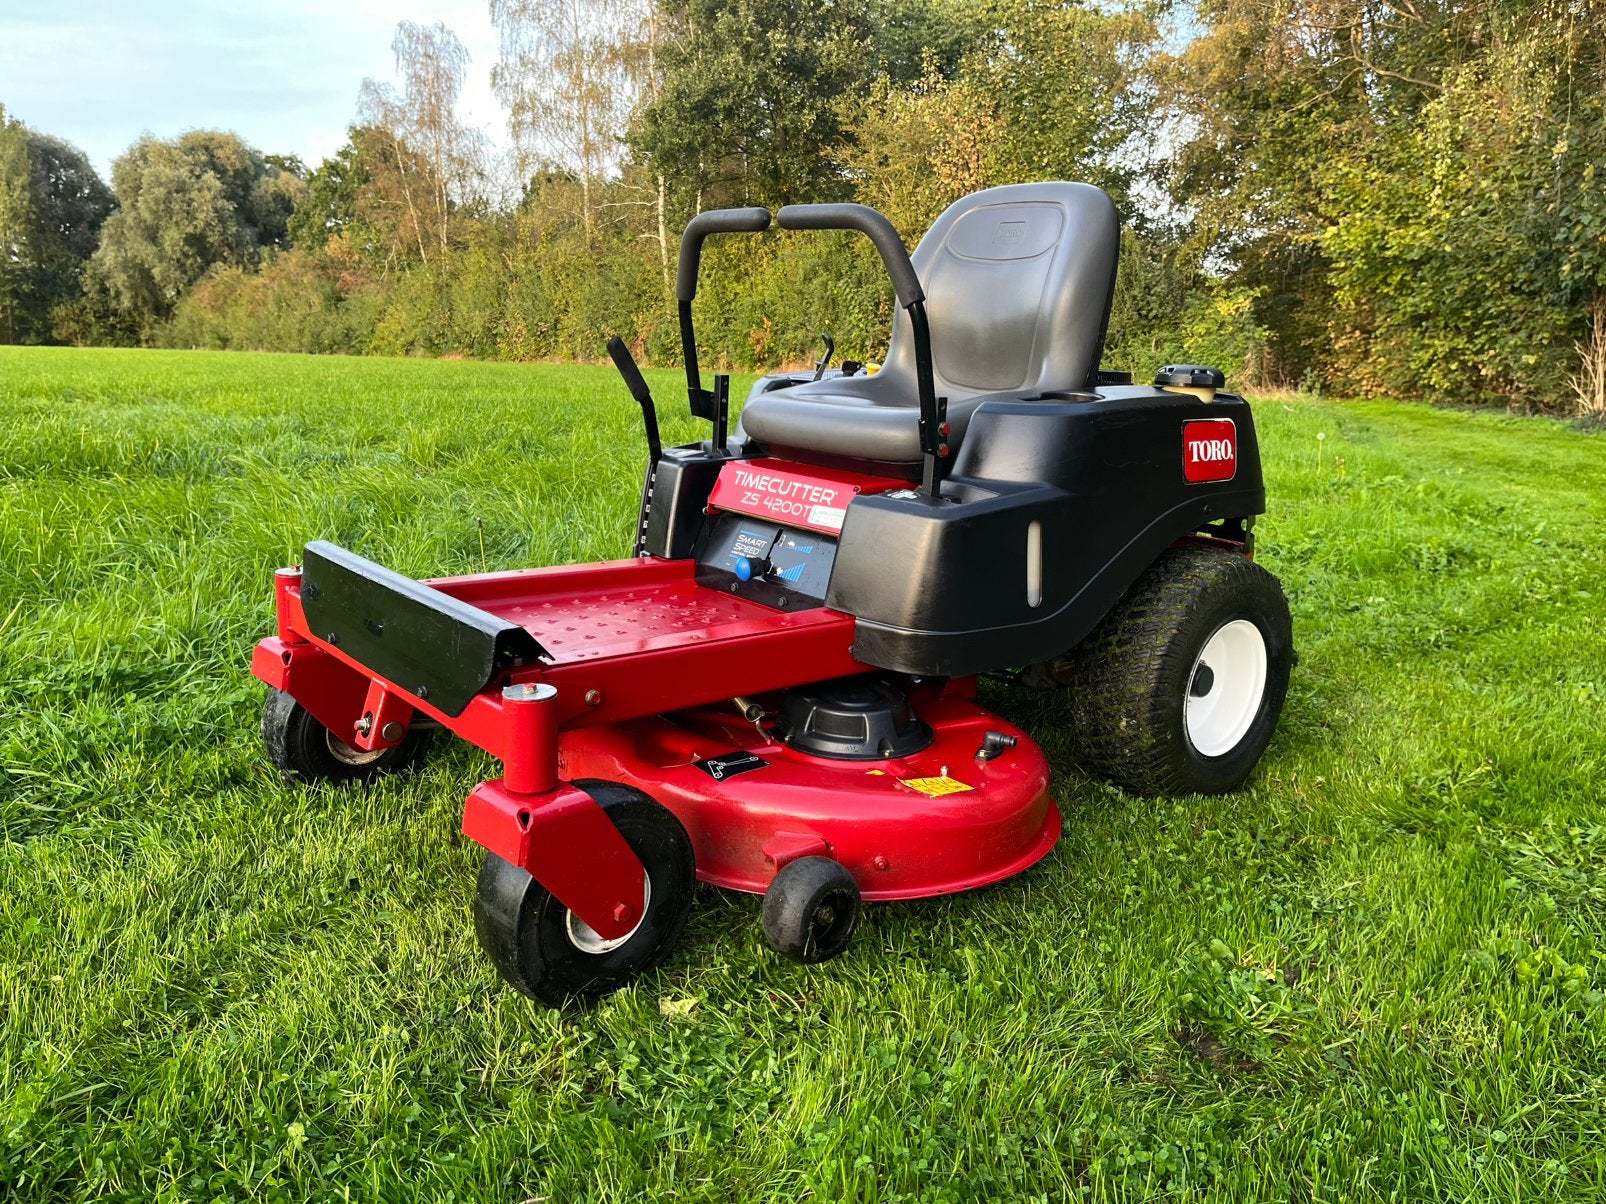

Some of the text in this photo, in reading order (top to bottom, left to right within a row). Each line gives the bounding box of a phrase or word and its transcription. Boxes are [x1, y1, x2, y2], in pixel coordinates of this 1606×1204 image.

[1189, 439, 1232, 462] TORO
[735, 470, 836, 505] TIMECUTTER
[741, 491, 761, 505] ZS
[763, 496, 812, 518] 4200T
[733, 542, 760, 555] SPEED
[737, 534, 768, 548] SMART
